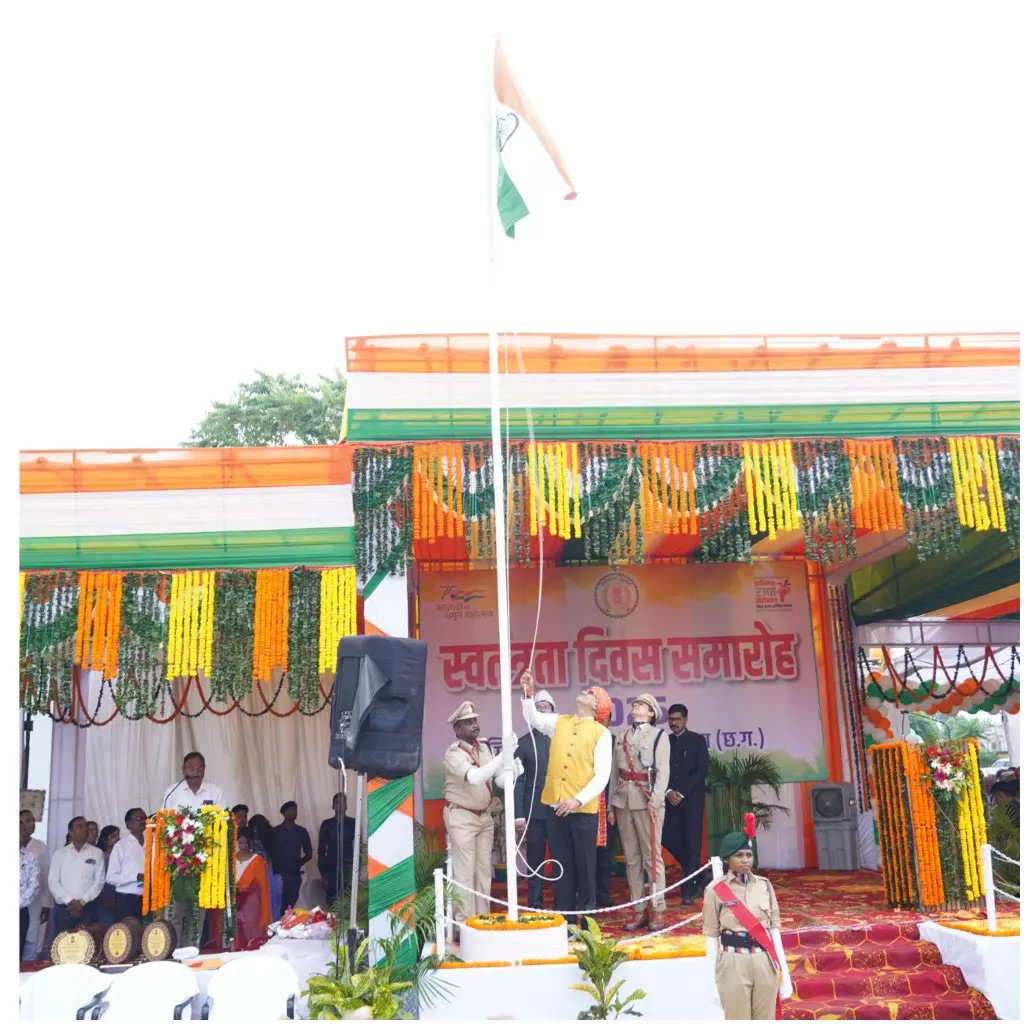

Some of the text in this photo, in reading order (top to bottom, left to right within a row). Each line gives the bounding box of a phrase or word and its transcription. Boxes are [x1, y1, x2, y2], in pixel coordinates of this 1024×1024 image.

[440, 621, 795, 688] स्वतत्रता दिवस समारोह
[716, 727, 764, 751] (छ.ग.)
